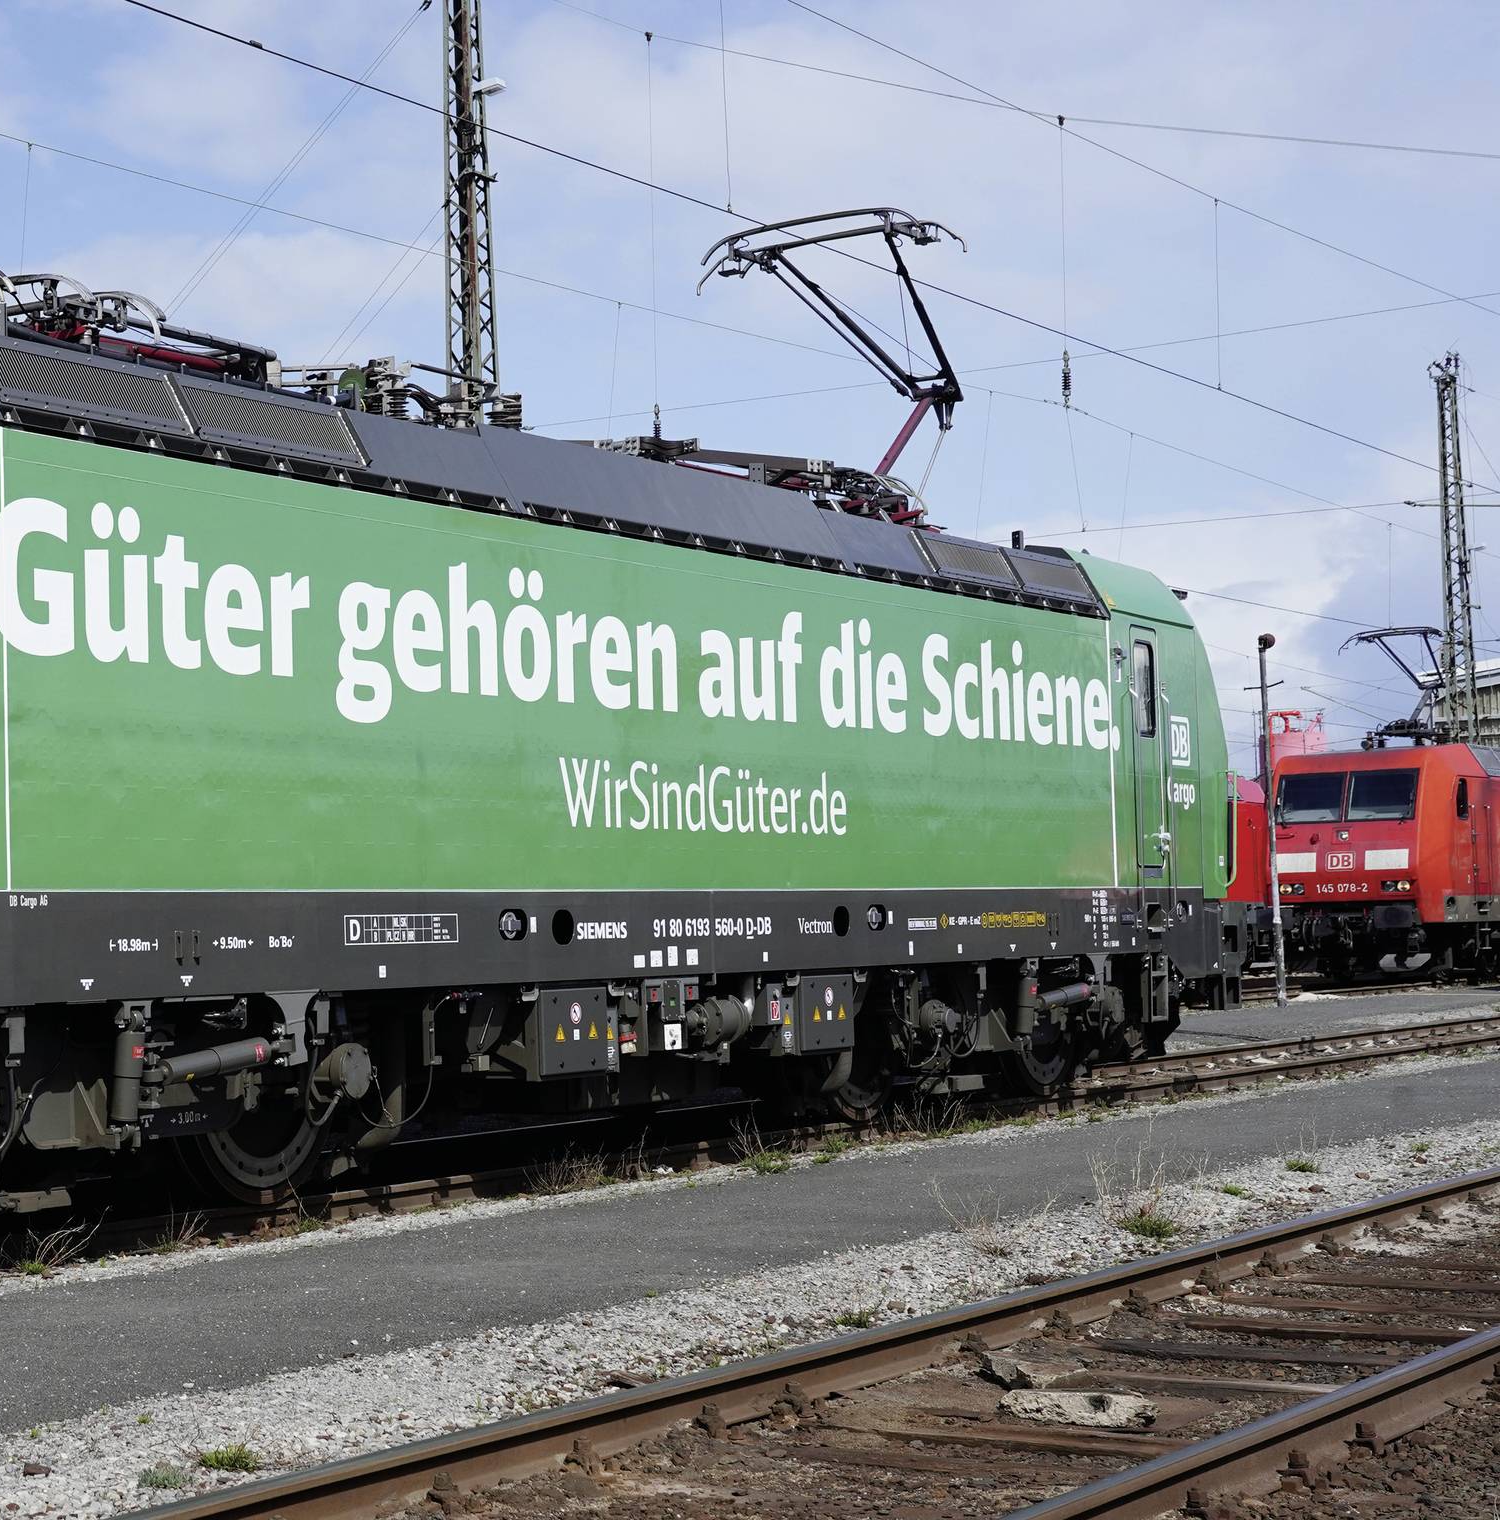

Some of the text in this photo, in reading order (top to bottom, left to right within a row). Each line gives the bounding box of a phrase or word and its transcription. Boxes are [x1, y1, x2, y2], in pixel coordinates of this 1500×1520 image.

[336, 562, 679, 723] gehören
[699, 611, 802, 722] auf
[820, 618, 908, 734] die
[922, 633, 1121, 751] Schiene.
[1171, 722, 1188, 759] DB
[558, 757, 847, 835] WirSindGüter.de
[1329, 854, 1352, 868] DB
[1316, 883, 1369, 894] 145 078-2
[9, 894, 48, 909] DB Cargo AG
[349, 919, 361, 941] D
[576, 921, 628, 940] SIEMENS
[653, 916, 772, 940] 91 80 6193 560-0 D-DB
[797, 917, 833, 934] Vectron
[219, 936, 247, 950] 9.50m
